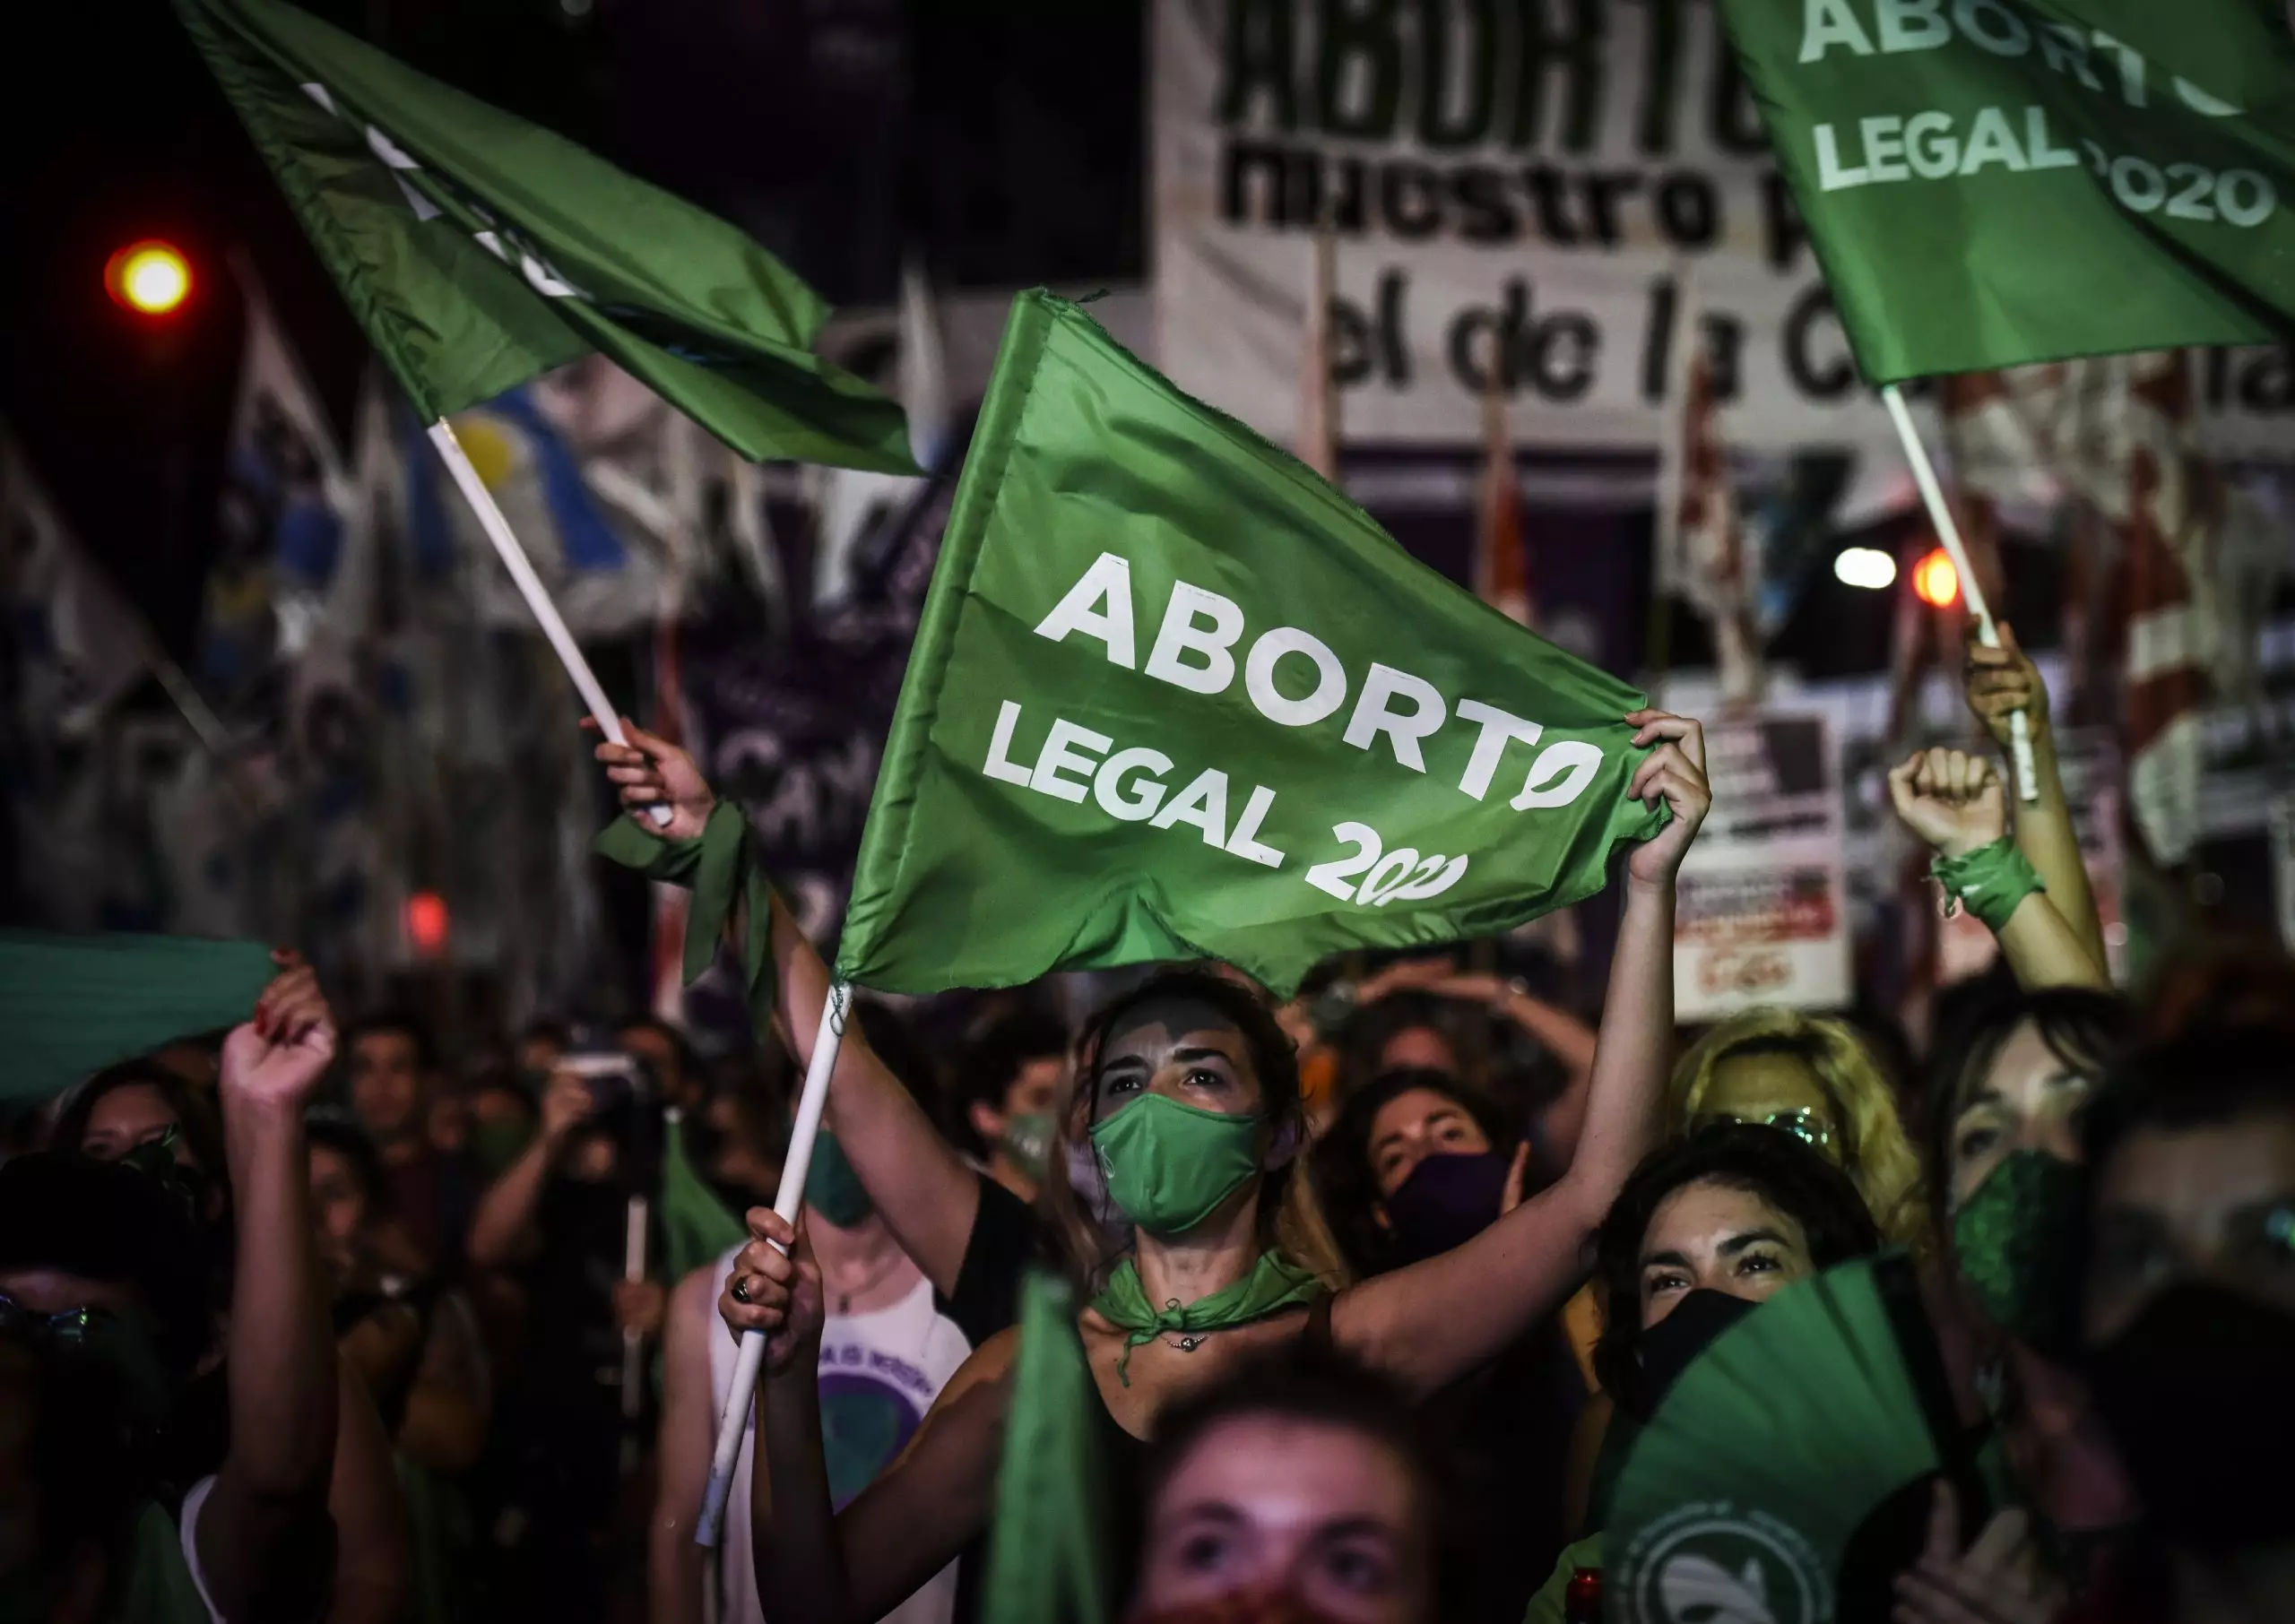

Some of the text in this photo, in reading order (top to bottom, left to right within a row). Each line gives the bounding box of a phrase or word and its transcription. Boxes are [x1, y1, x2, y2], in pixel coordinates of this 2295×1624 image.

[1220, 140, 1721, 252] nuestro
[1812, 106, 2080, 194] LEGAL
[1446, 276, 1600, 403] de
[982, 699, 1286, 869] LEGAL
